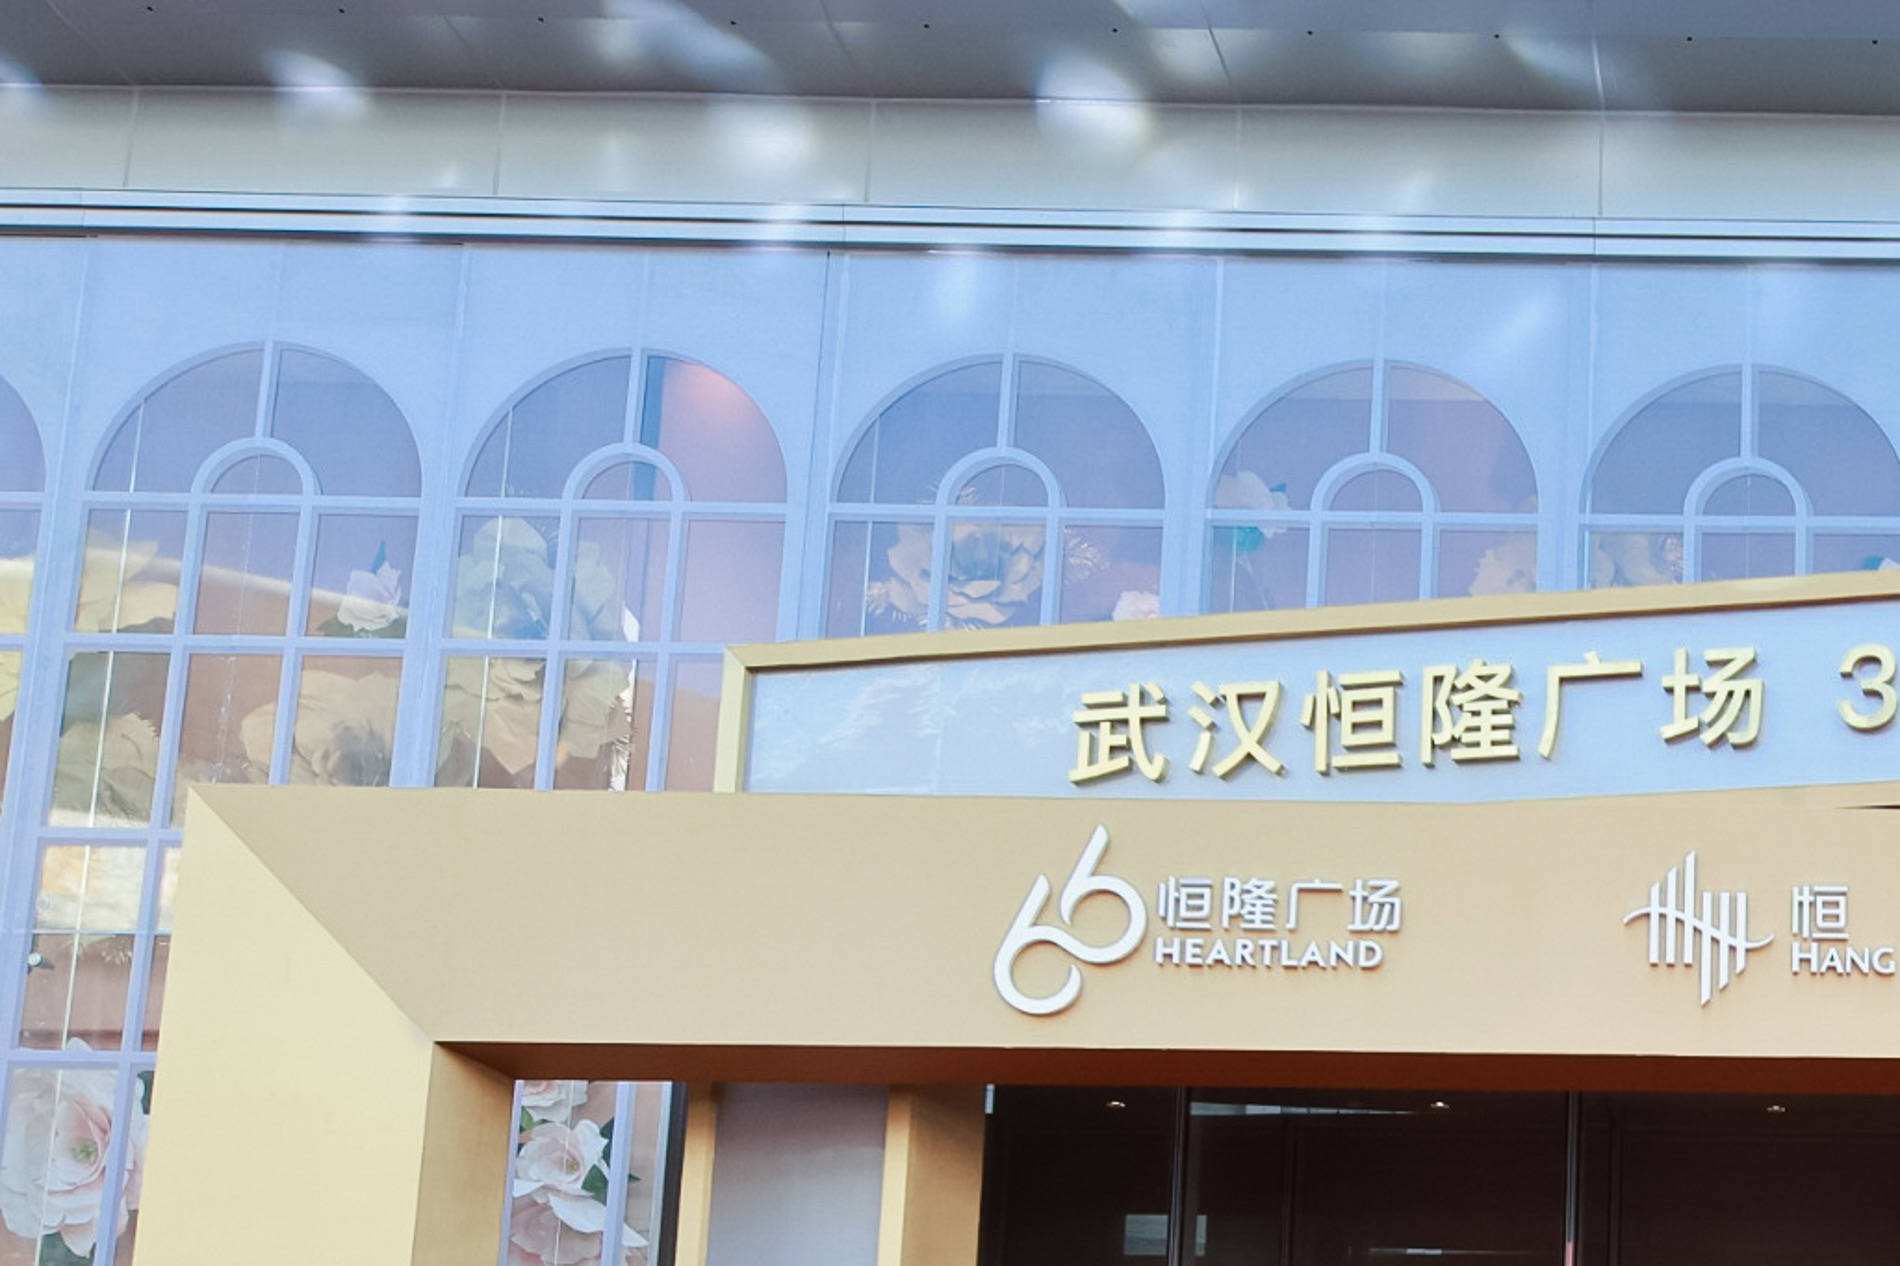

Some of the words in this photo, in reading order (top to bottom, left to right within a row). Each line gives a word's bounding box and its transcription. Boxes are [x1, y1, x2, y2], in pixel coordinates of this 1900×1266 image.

[1068, 648, 1766, 785] 武汉恒隆广场
[1156, 876, 1402, 933] 恒隆广场
[1154, 936, 1384, 970] HEARTLAND
[1790, 943, 1896, 975] HANG
